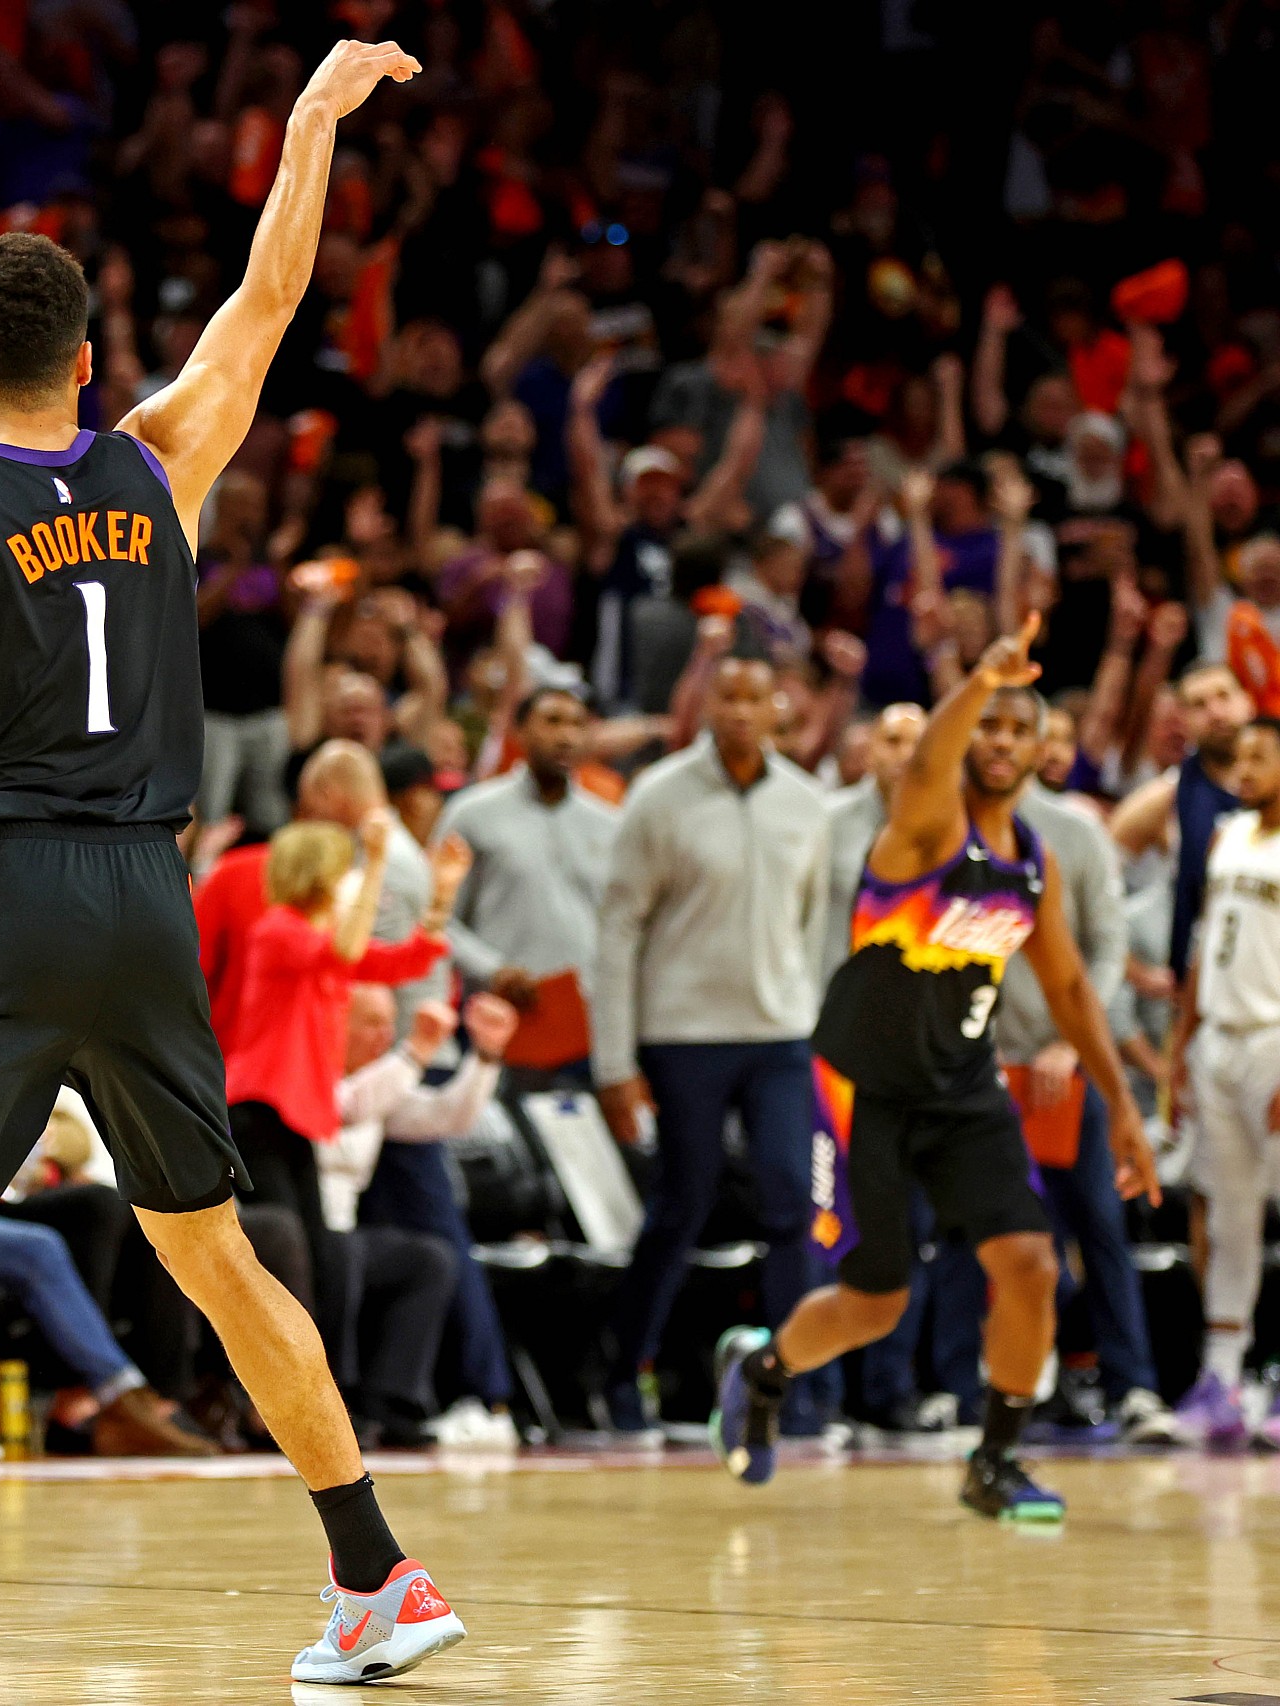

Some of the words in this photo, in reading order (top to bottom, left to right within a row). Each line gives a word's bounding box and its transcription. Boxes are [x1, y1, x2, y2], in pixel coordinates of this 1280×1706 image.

[6, 510, 153, 585] BOOKER
[72, 580, 119, 735] 1
[960, 984, 998, 1039] 3
